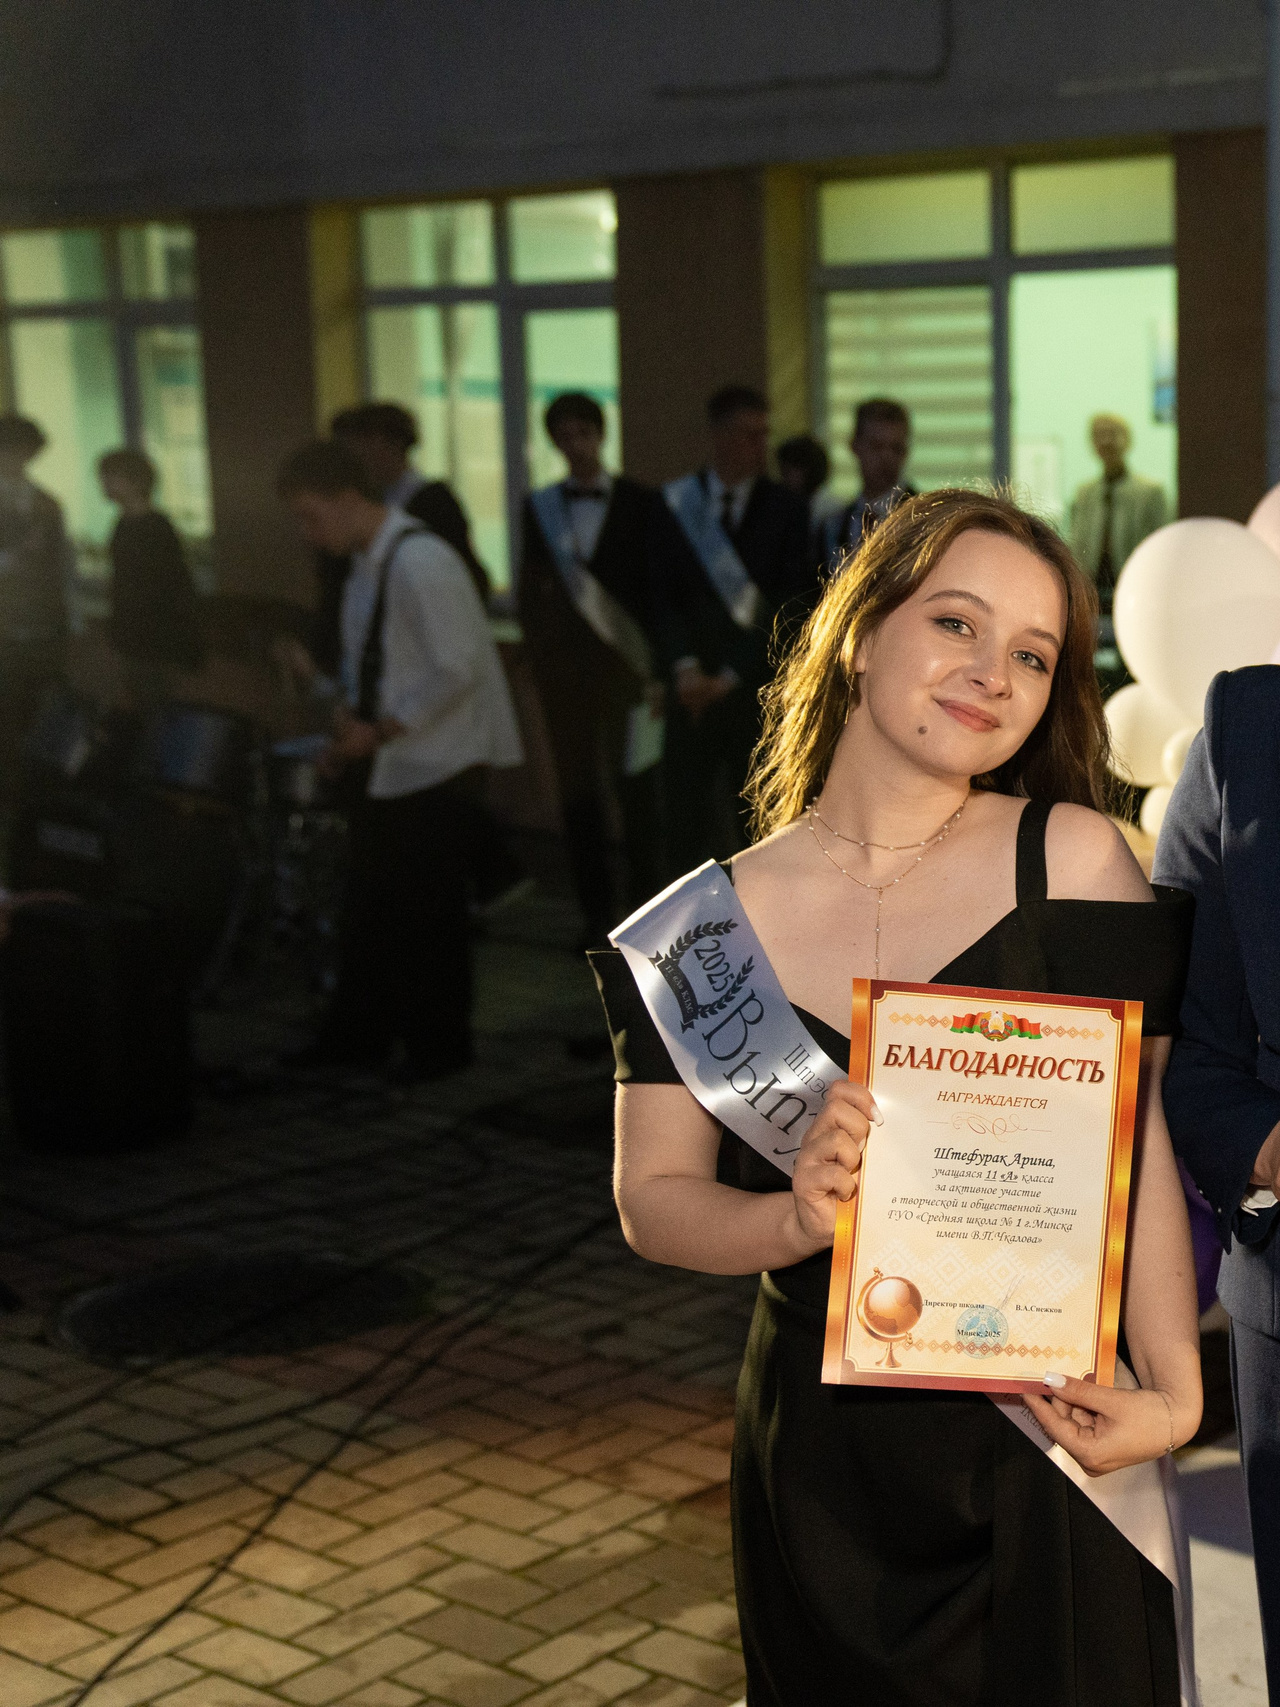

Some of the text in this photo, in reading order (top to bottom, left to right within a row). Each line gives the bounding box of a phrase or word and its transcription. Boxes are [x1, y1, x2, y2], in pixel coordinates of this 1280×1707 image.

[693, 939, 735, 992] 2025
[883, 1043, 1105, 1084] БЛАГОДАРНОСТЬ
[937, 1090, 1048, 1109] НАГРАЖДАЕТСЯ
[934, 1147, 1055, 1169] Штефурак Арина,
[932, 1168, 1054, 1184] учащаяся 11 «А» класса
[935, 1184, 1041, 1198] за активное участие
[891, 1196, 897, 1204] в
[900, 1197, 958, 1209] творческой
[970, 1199, 1042, 1213] общественной
[1043, 1206, 1077, 1216] жизни
[887, 1210, 1073, 1233] ГУО «Средняя школа № 1 г.Минска
[936, 1230, 1042, 1244] имени В.П.Чкалова»
[923, 1299, 957, 1308] Директор
[984, 1330, 1001, 1338] 2025
